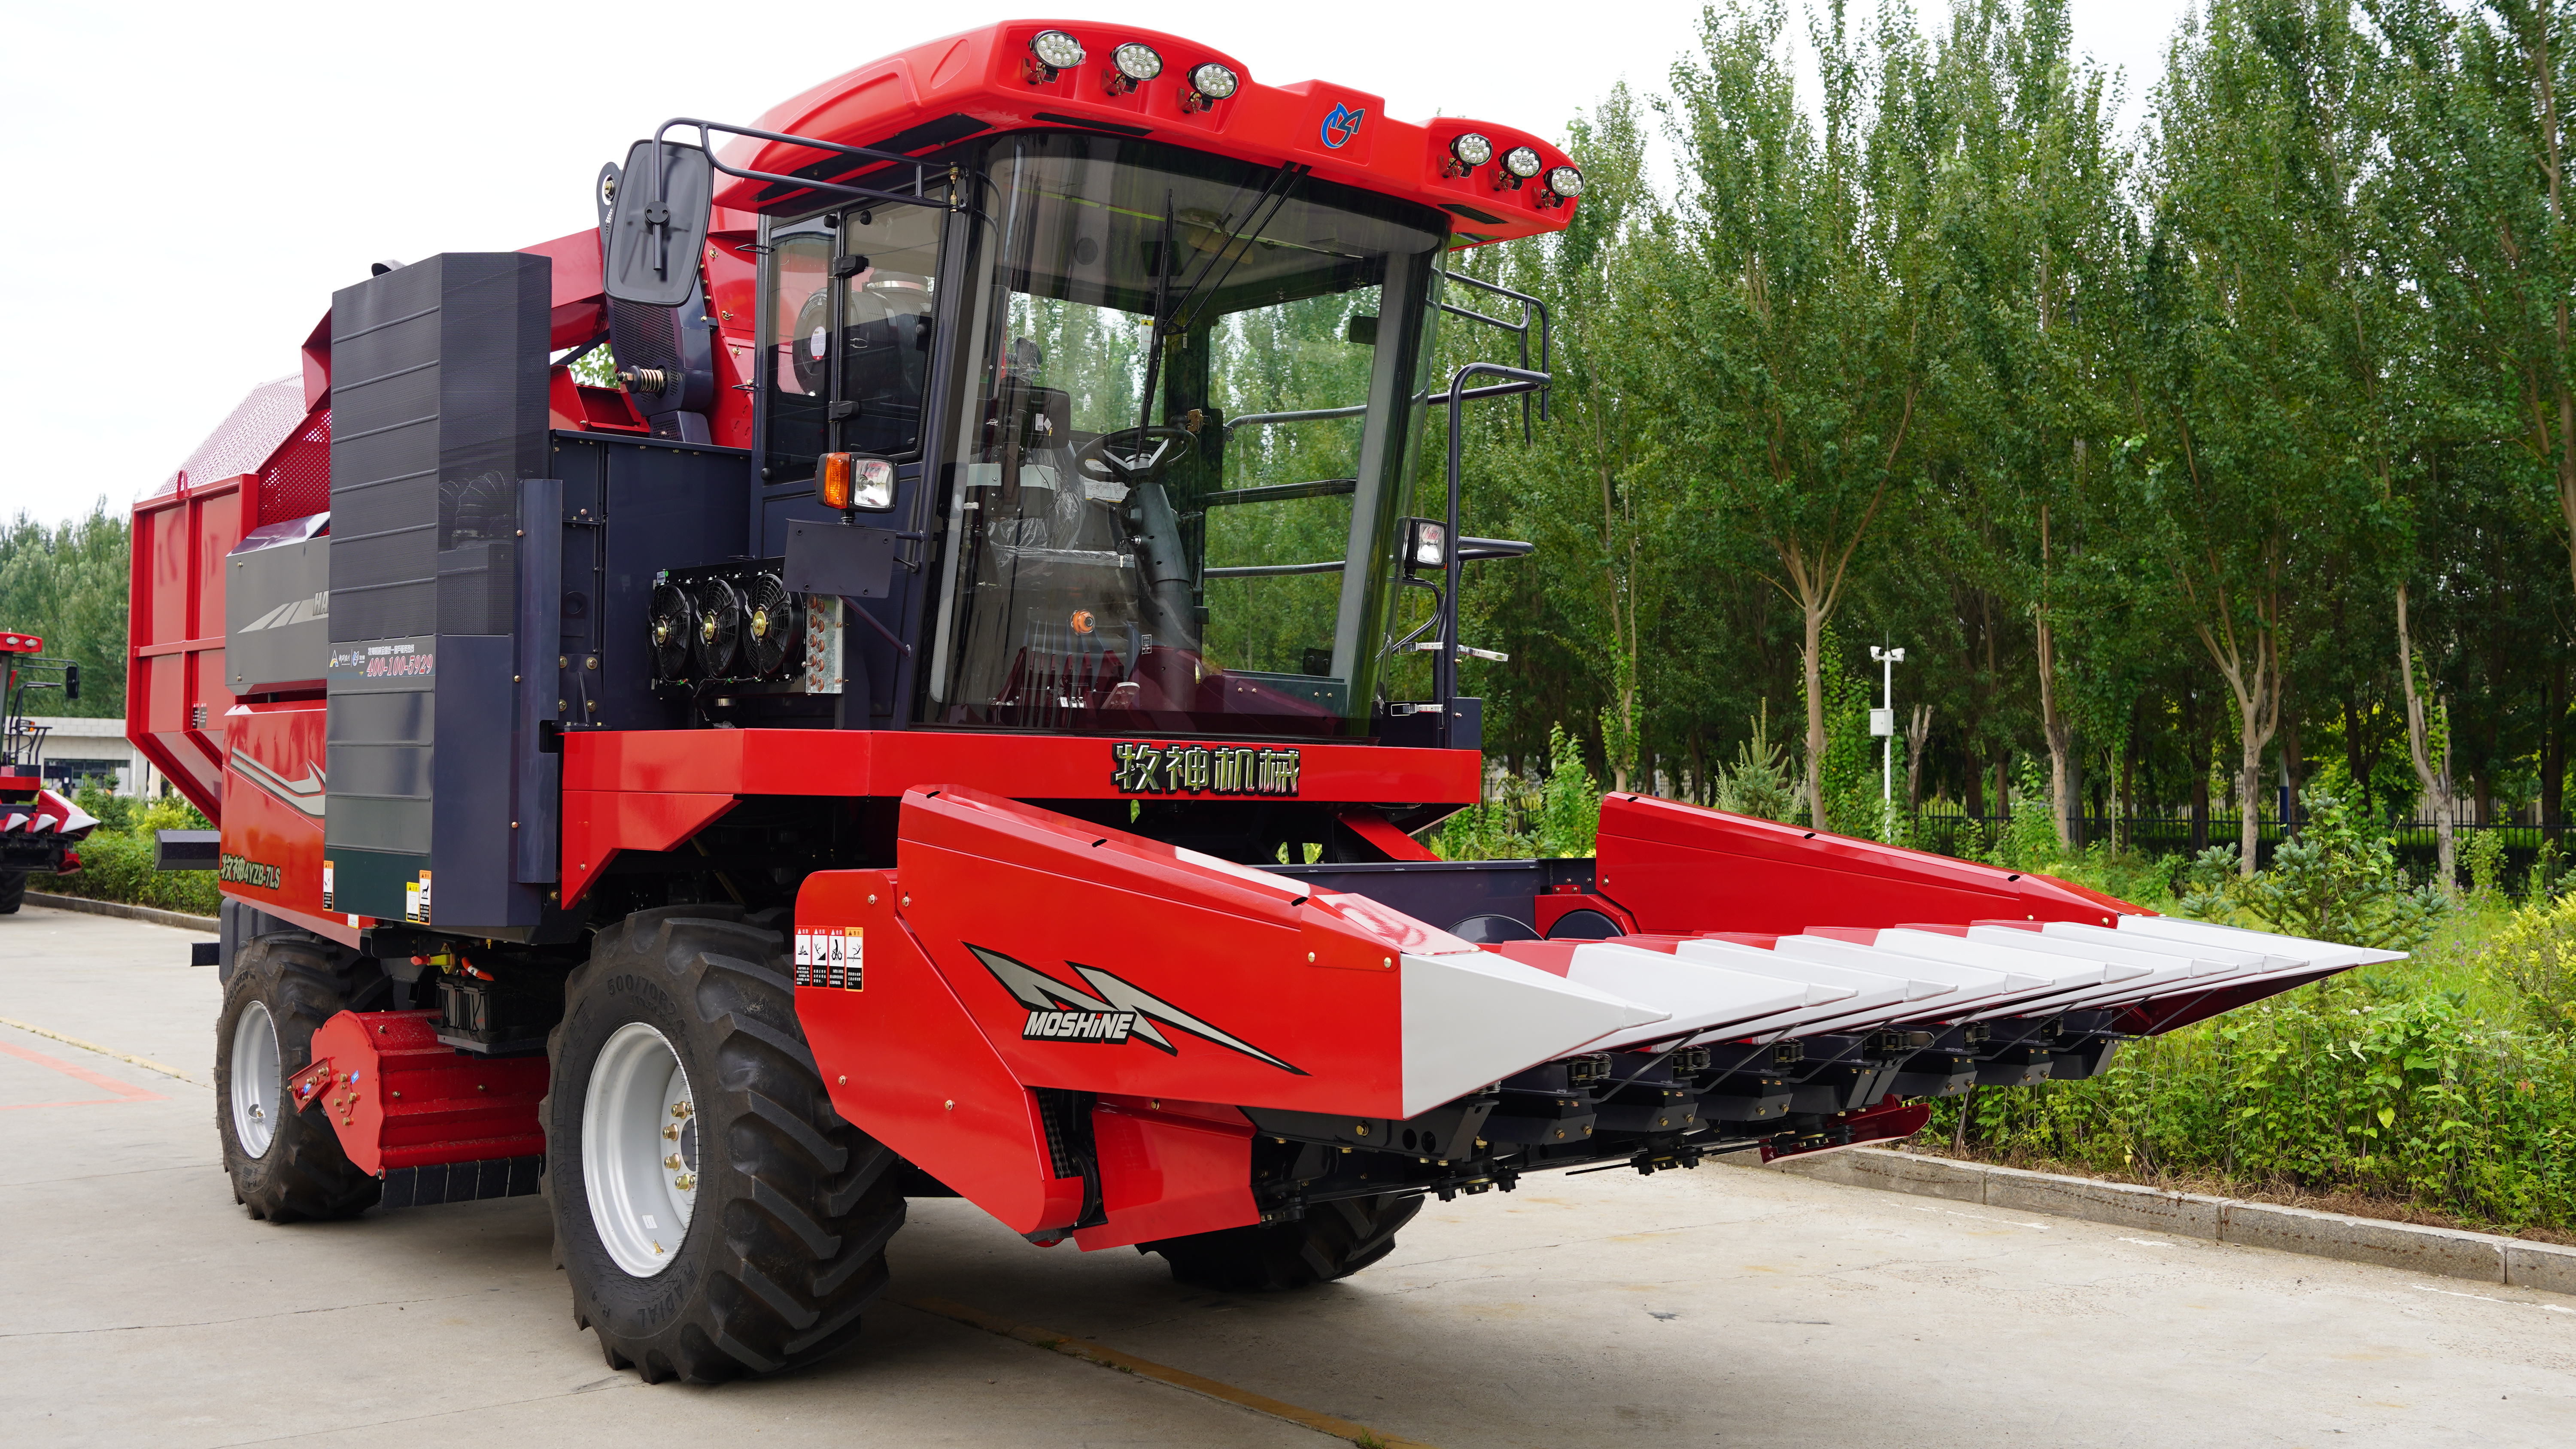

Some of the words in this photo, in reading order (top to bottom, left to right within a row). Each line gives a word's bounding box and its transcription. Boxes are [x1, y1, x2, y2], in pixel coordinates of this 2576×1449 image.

[367, 654, 433, 677] 400-100-5929
[1114, 743, 1300, 794] 牧神机械
[219, 853, 281, 889] 牧神4YZB-7LS
[637, 1260, 697, 1330] RADIAL
